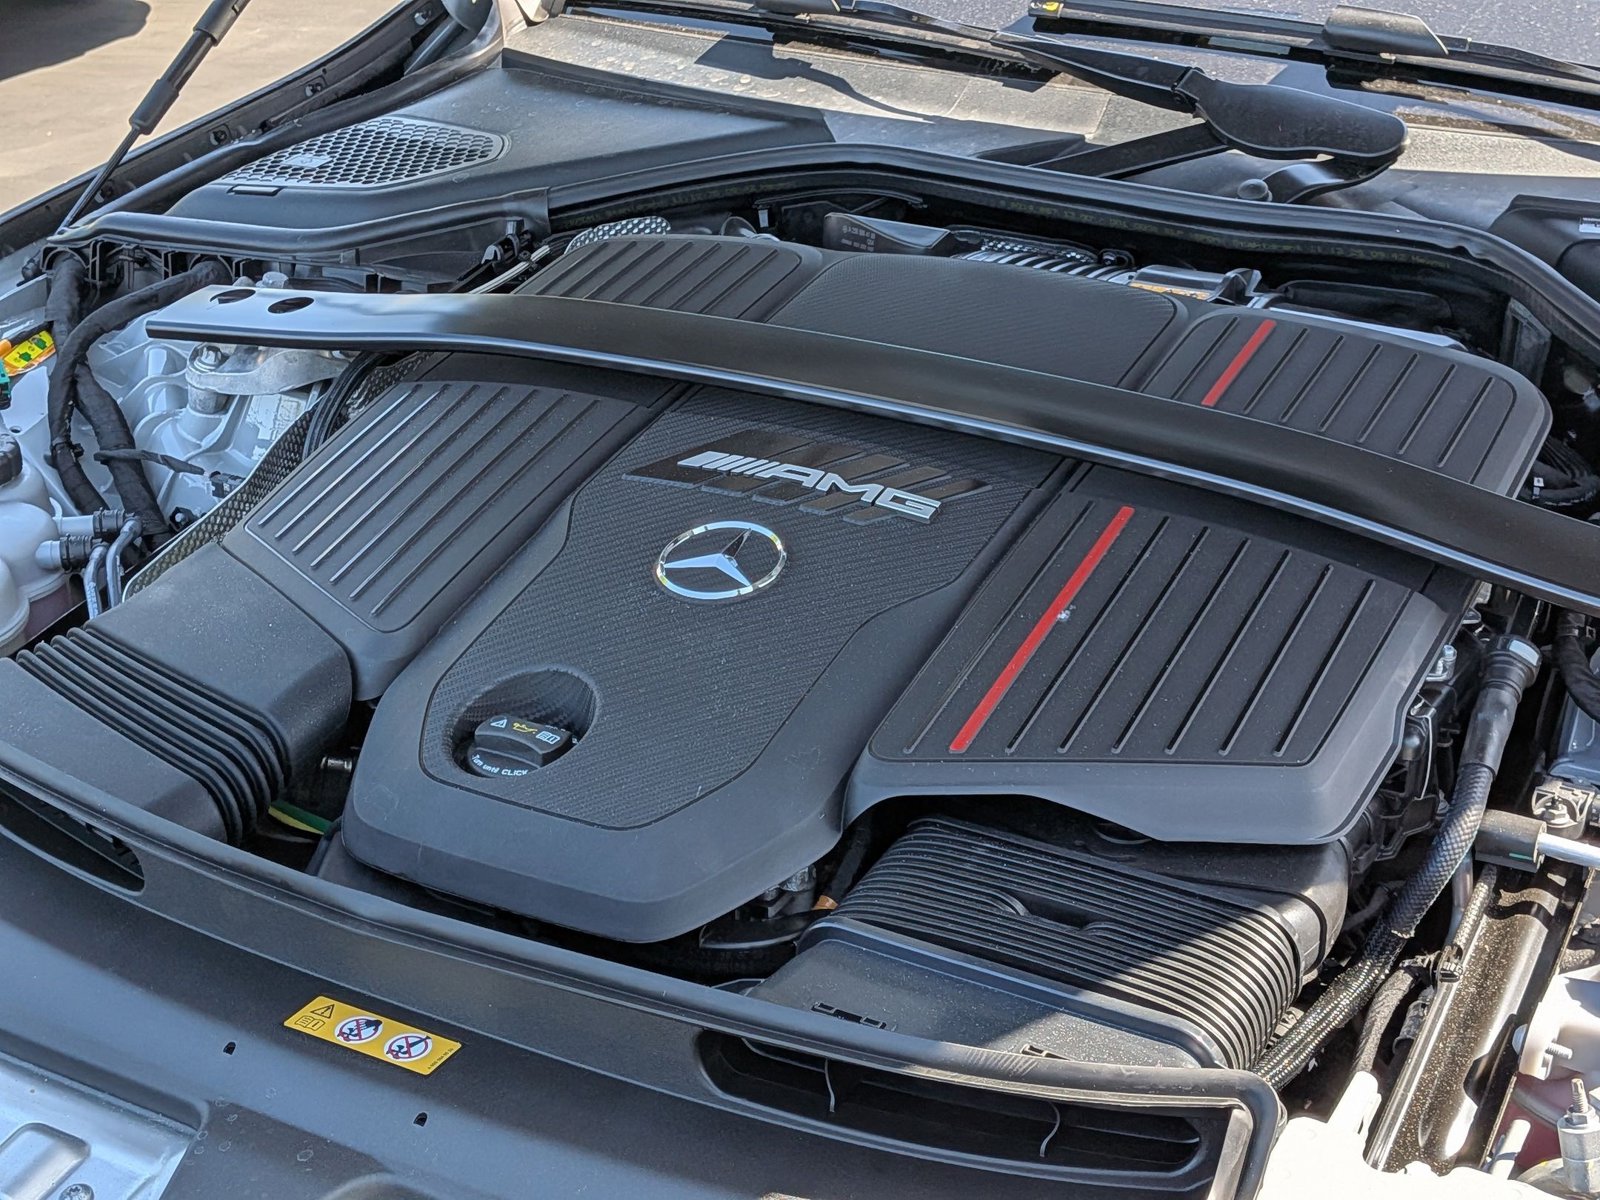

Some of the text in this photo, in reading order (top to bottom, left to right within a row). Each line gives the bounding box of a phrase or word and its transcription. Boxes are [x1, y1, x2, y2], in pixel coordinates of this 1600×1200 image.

[757, 461, 941, 521] AMG
[472, 754, 483, 766] Turn
[482, 763, 500, 774] until
